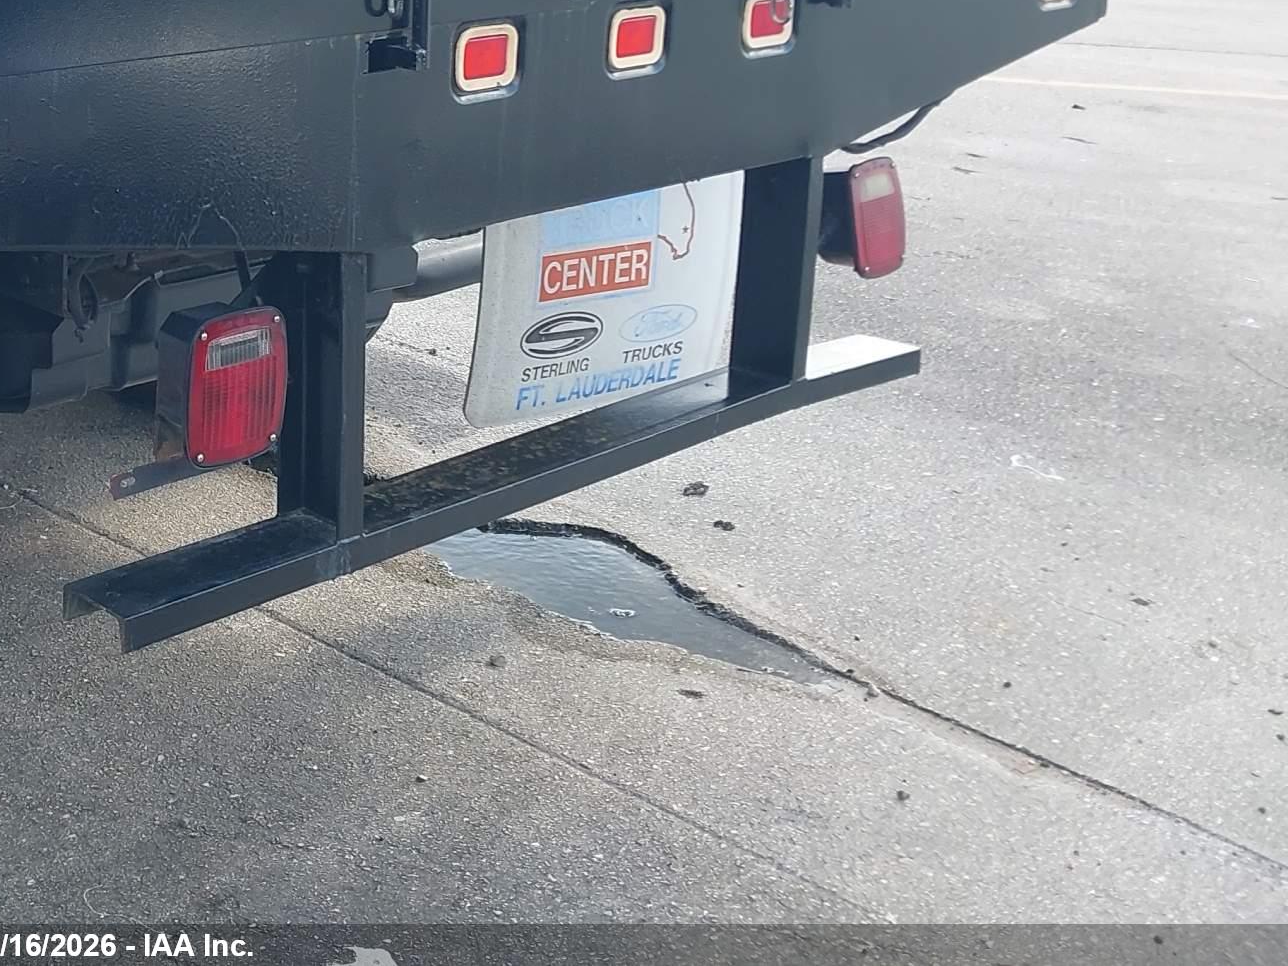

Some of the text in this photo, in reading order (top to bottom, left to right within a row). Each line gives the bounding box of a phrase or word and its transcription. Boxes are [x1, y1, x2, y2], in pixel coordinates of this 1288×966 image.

[542, 248, 648, 295] CENTER
[515, 358, 681, 411] FT. LAUDERDALE
[521, 341, 683, 382] STERLING TRUCKS
